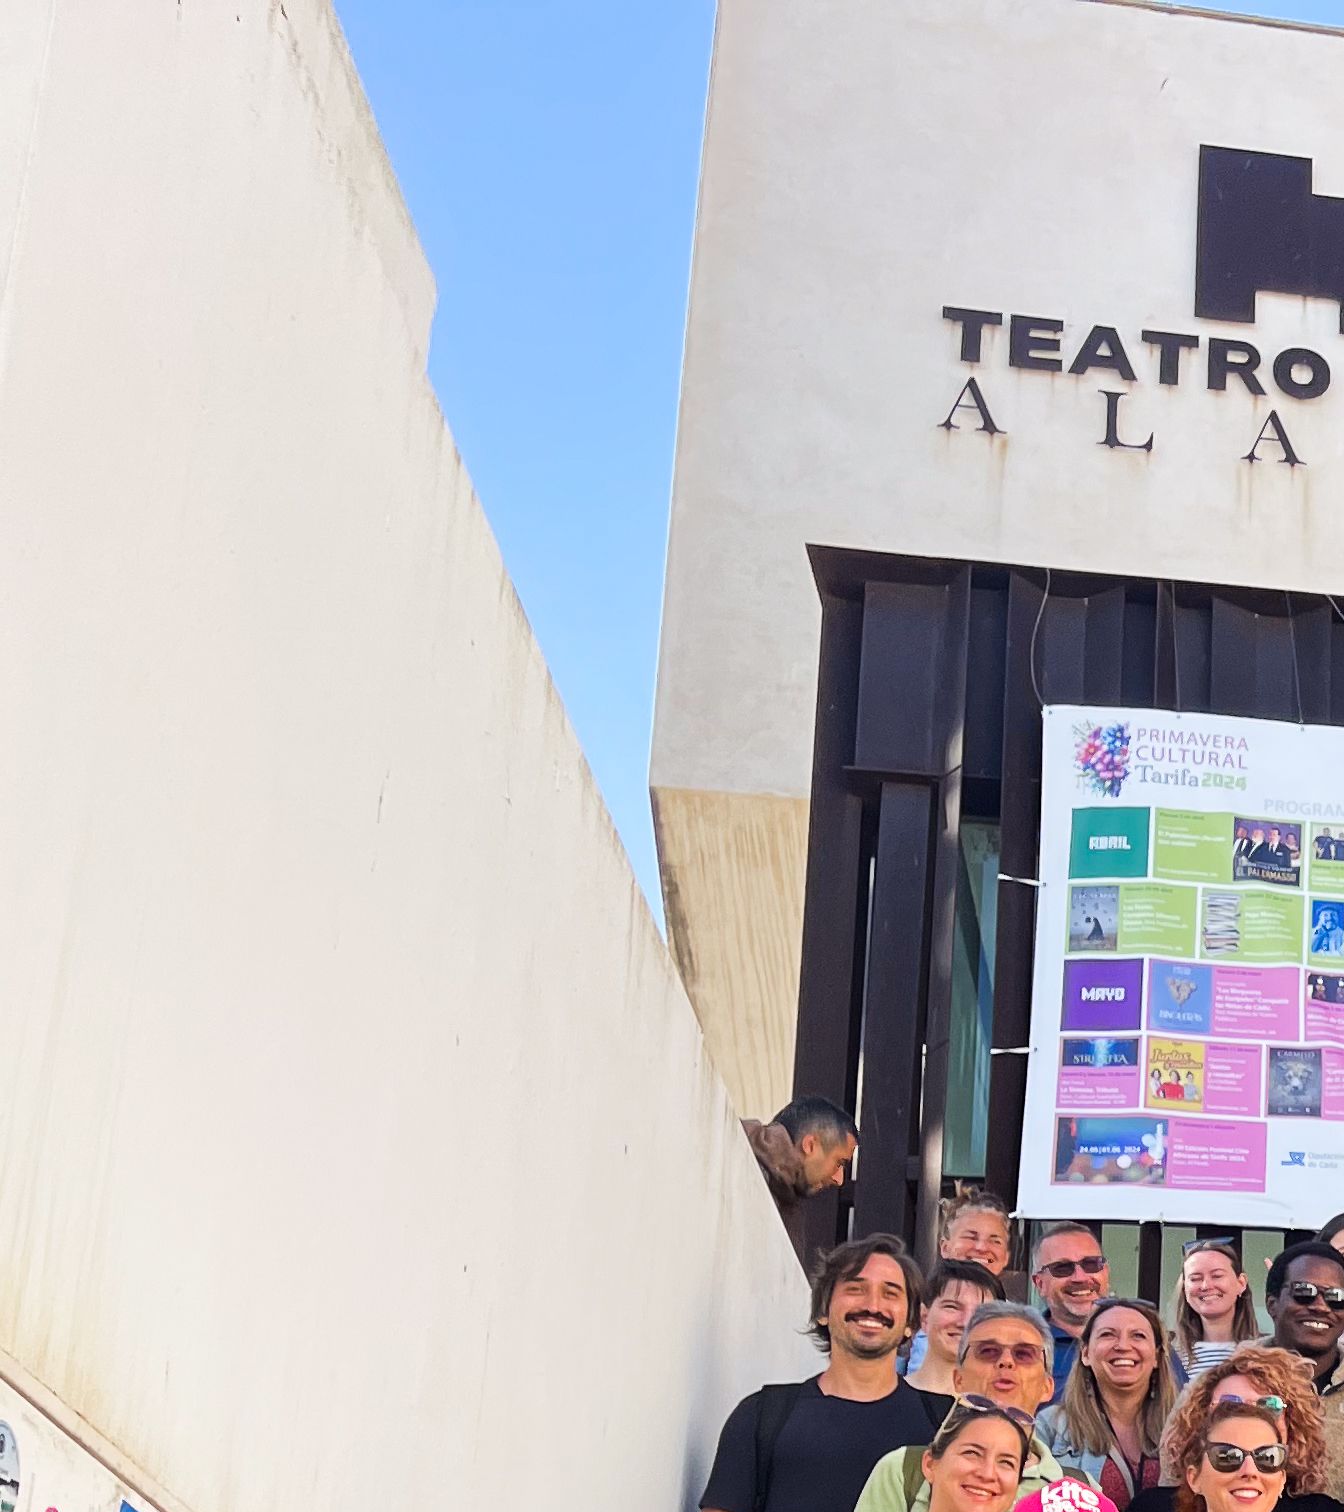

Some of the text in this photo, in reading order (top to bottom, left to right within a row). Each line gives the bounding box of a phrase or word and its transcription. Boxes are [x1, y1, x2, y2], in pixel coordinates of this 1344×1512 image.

[942, 305, 1331, 400] TEATRO
[1136, 728, 1249, 751] PRIMAVERA
[1135, 746, 1249, 770] CULTURAL
[1135, 765, 1247, 790] Tarifa 2024
[1089, 836, 1131, 850] ABRIL
[1081, 987, 1126, 1002] MAYO
